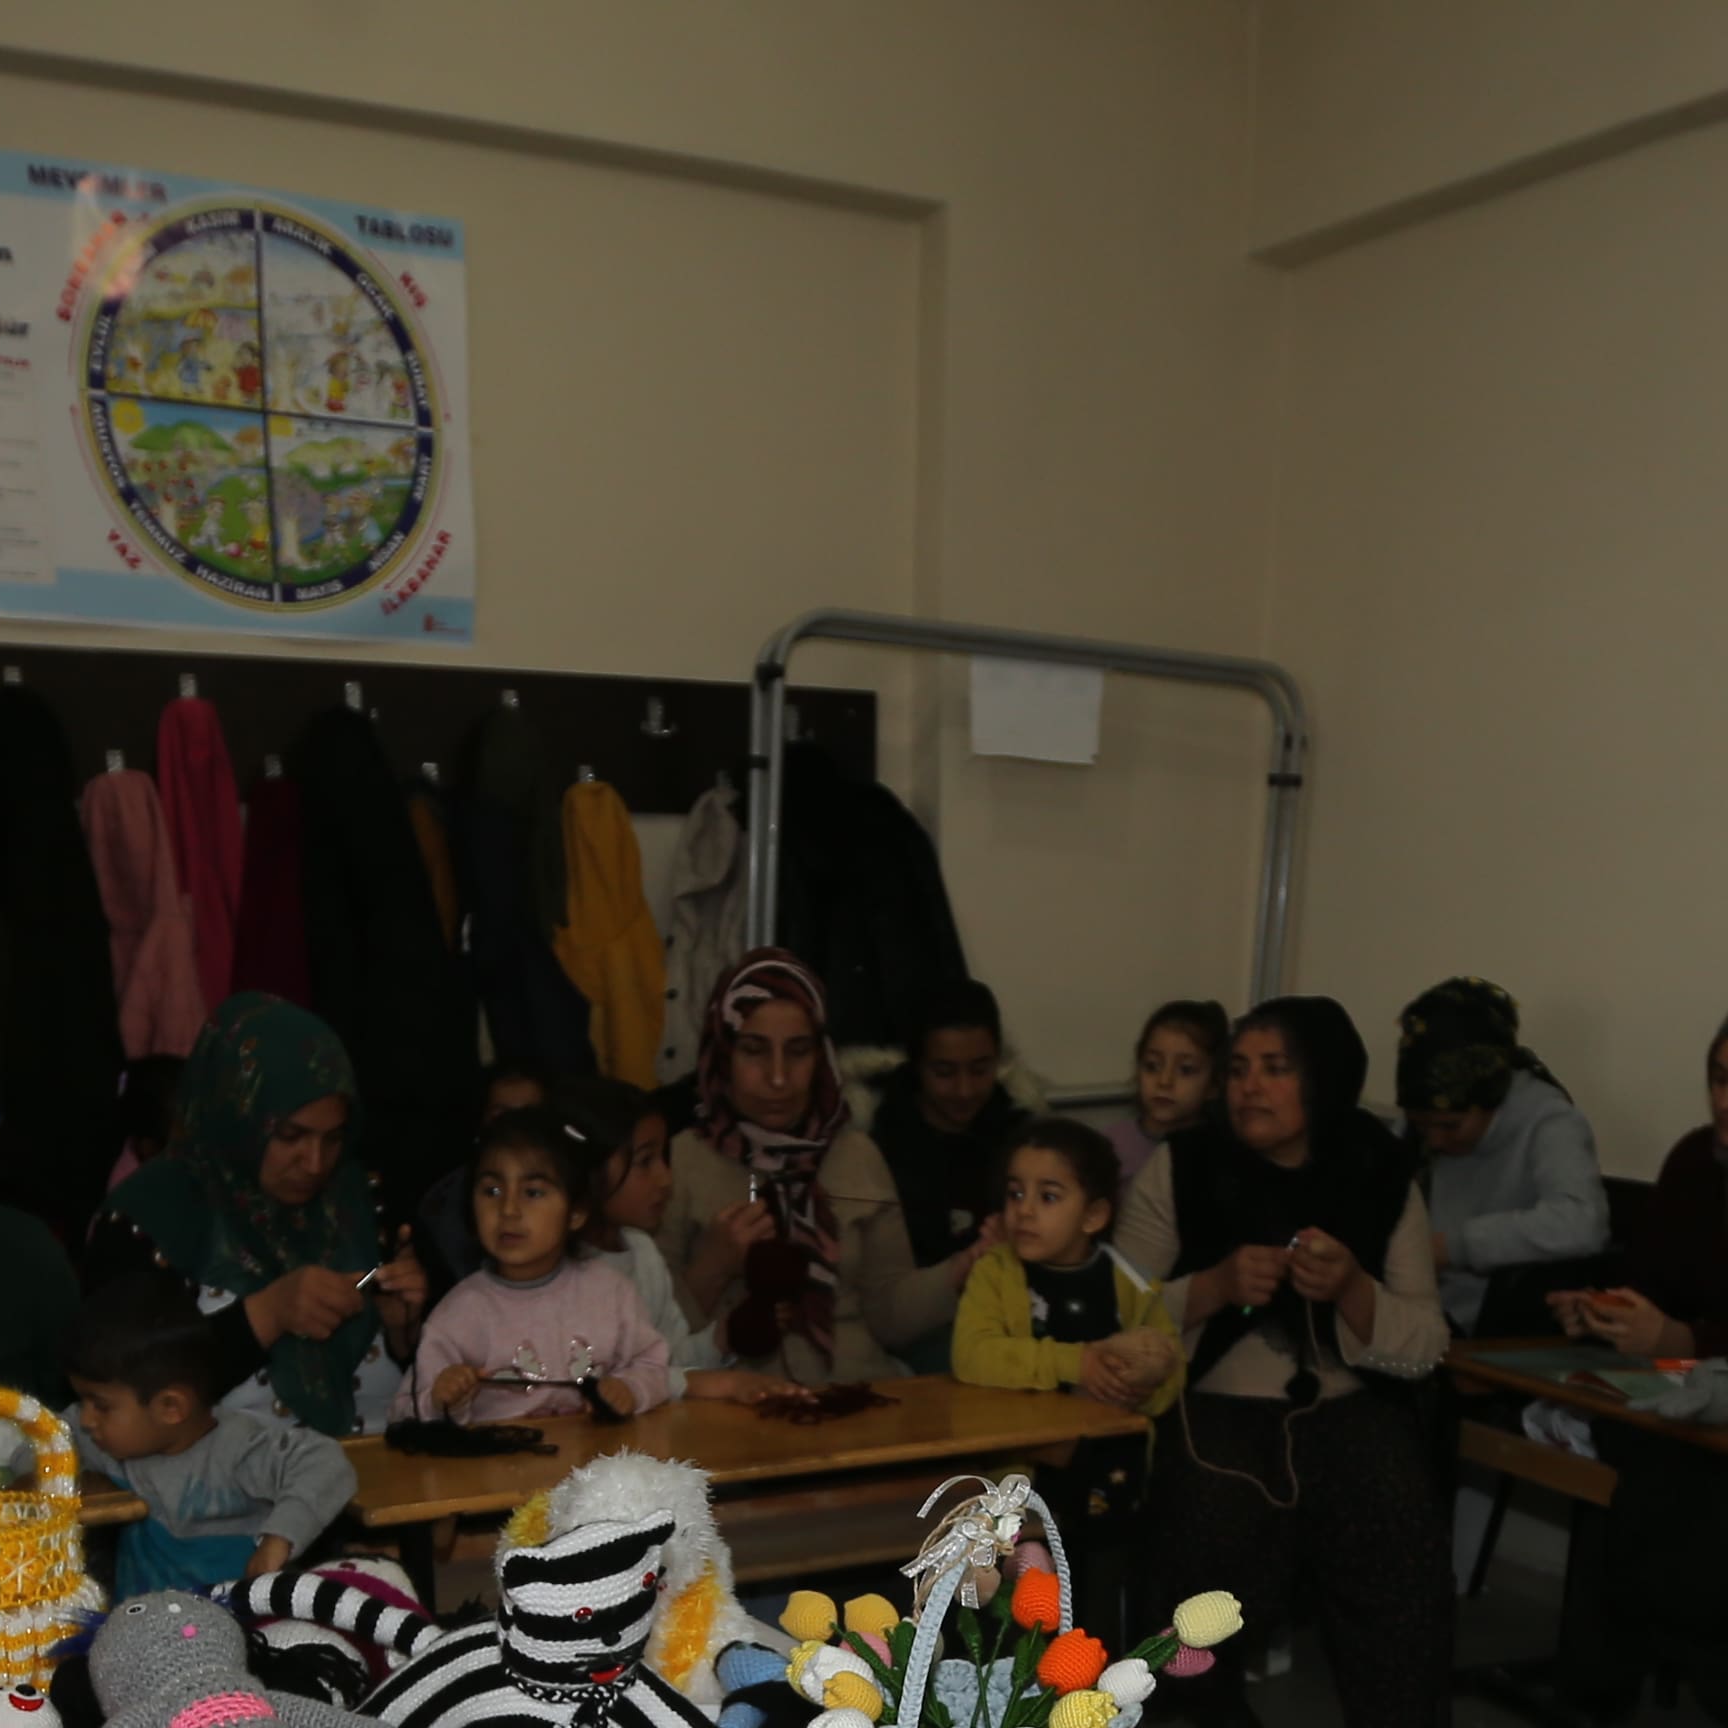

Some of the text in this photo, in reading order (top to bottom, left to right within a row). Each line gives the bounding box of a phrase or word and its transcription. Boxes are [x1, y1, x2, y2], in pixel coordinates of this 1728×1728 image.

[27, 164, 169, 206] MEVMLER
[355, 214, 455, 248] TABLOSU
[194, 564, 271, 600] HAZİRAN
